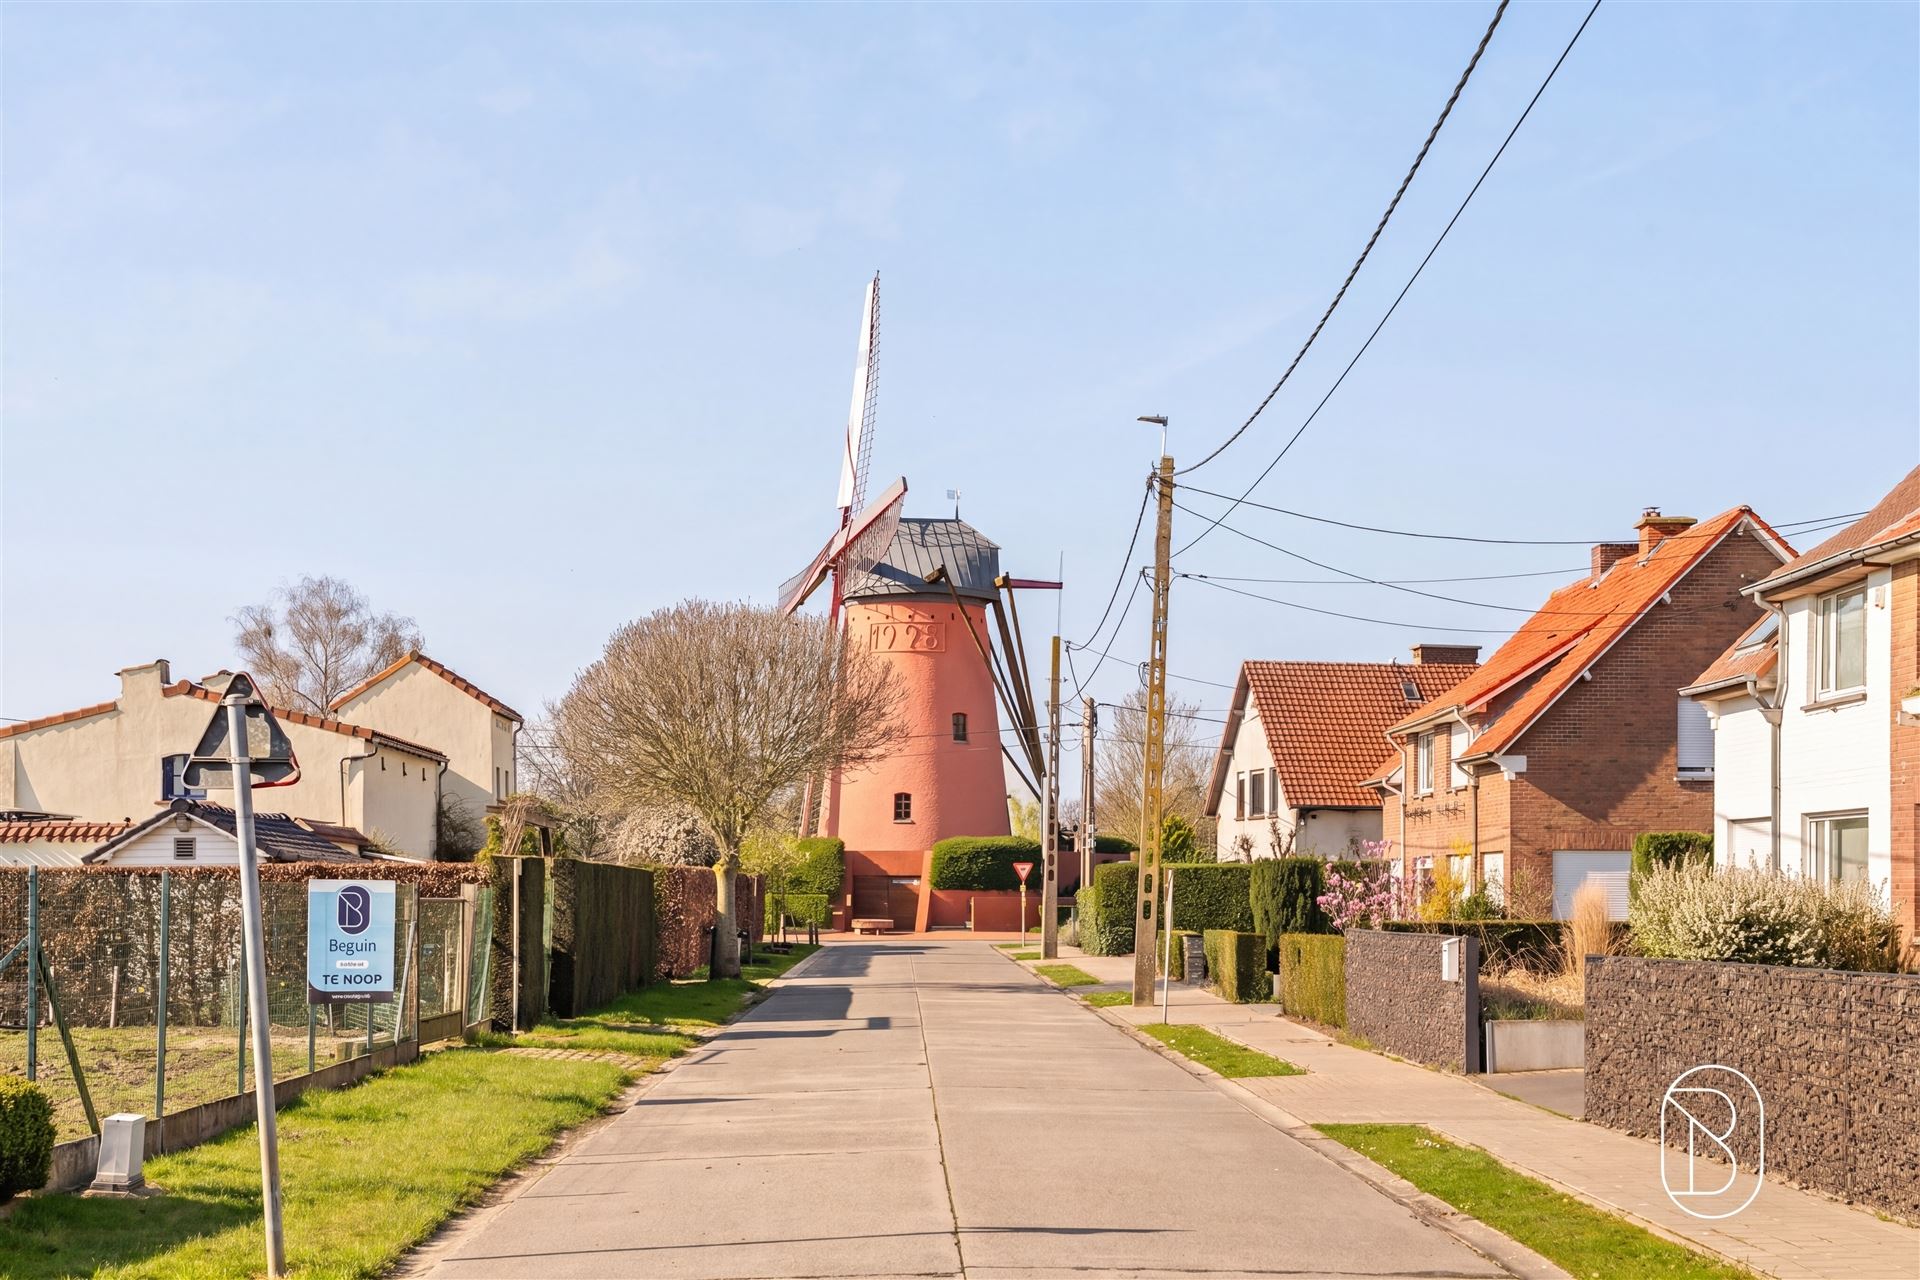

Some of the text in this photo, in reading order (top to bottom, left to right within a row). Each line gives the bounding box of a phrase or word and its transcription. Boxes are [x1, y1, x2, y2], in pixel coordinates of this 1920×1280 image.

[329, 938, 377, 956] Beguin
[322, 974, 383, 985] TE NOOP
